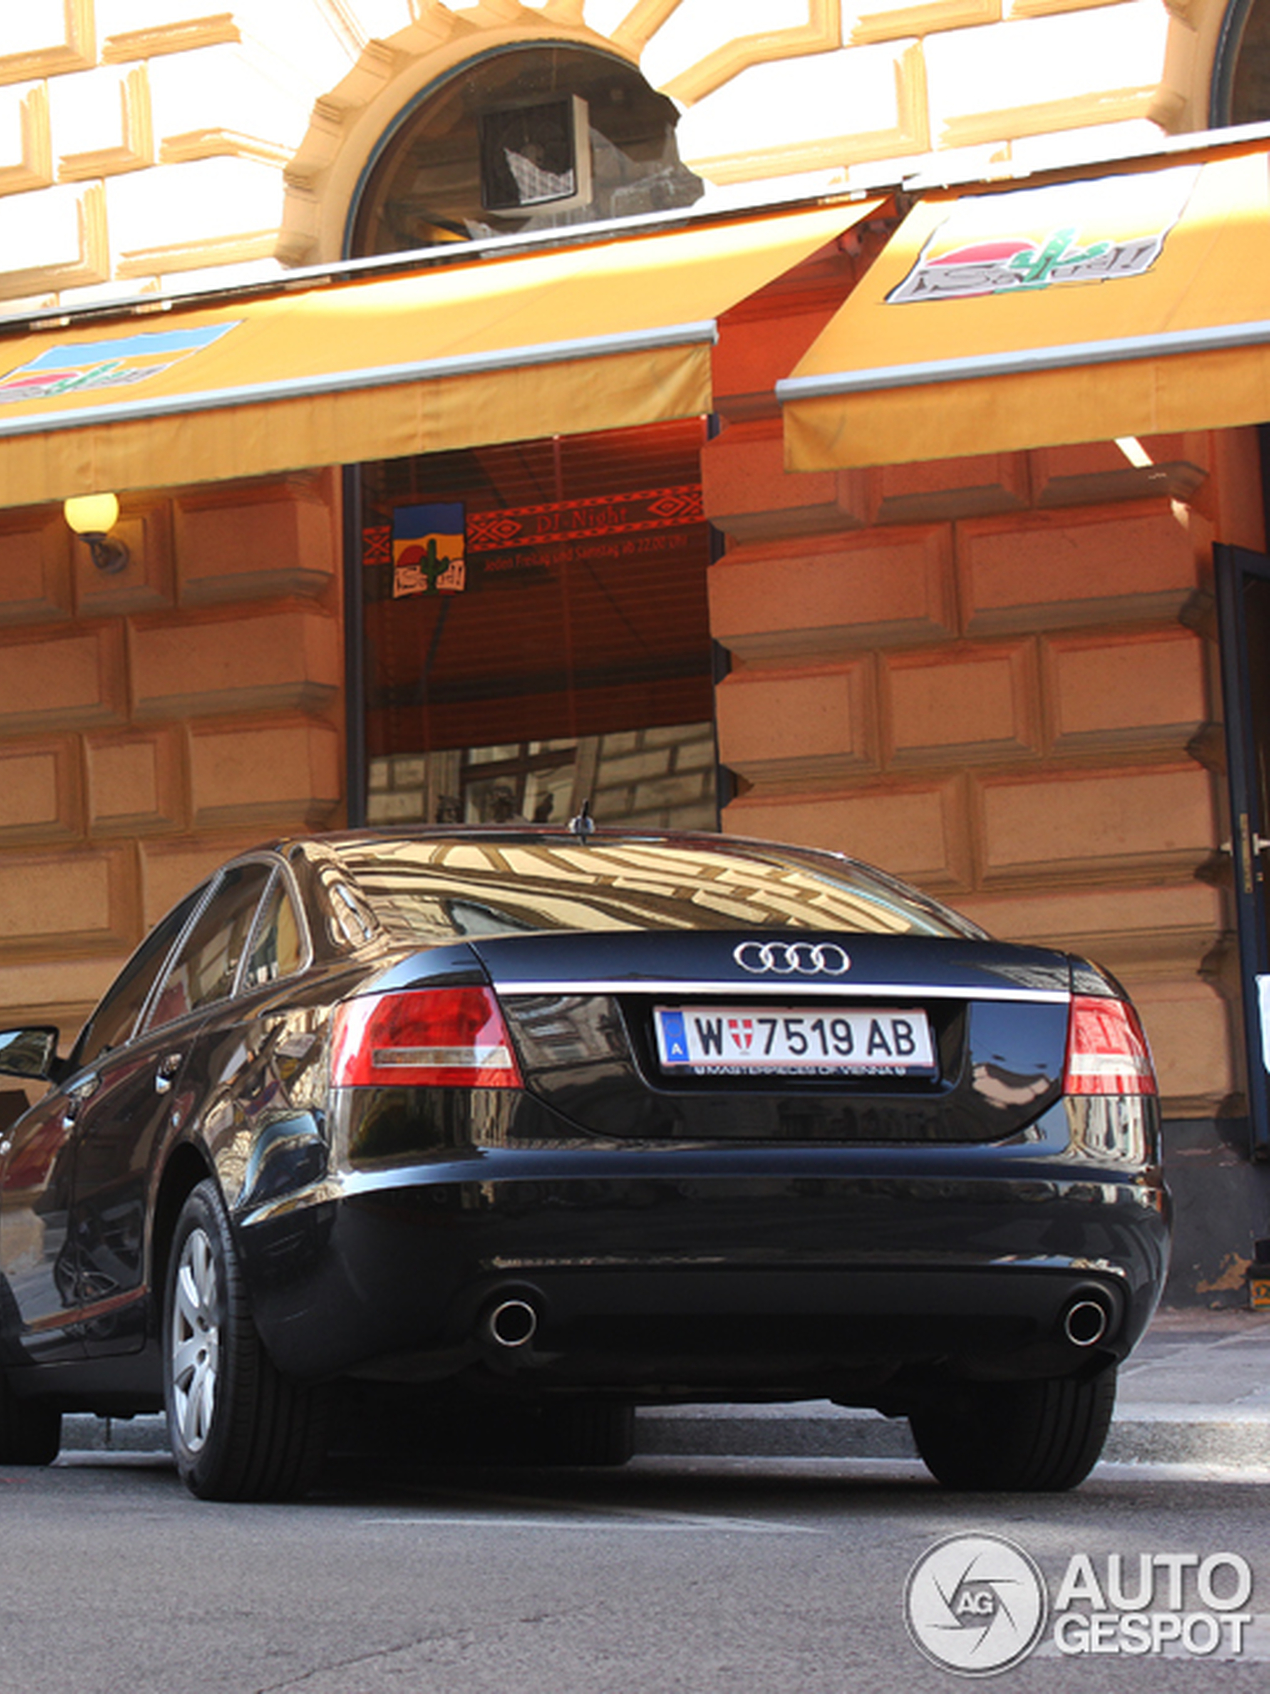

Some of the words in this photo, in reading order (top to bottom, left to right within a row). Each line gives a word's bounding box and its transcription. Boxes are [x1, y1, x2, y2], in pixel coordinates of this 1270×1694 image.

[671, 1043, 684, 1055] A
[695, 1018, 723, 1056] W
[757, 1018, 855, 1056] 7519
[867, 1019, 917, 1057] AB
